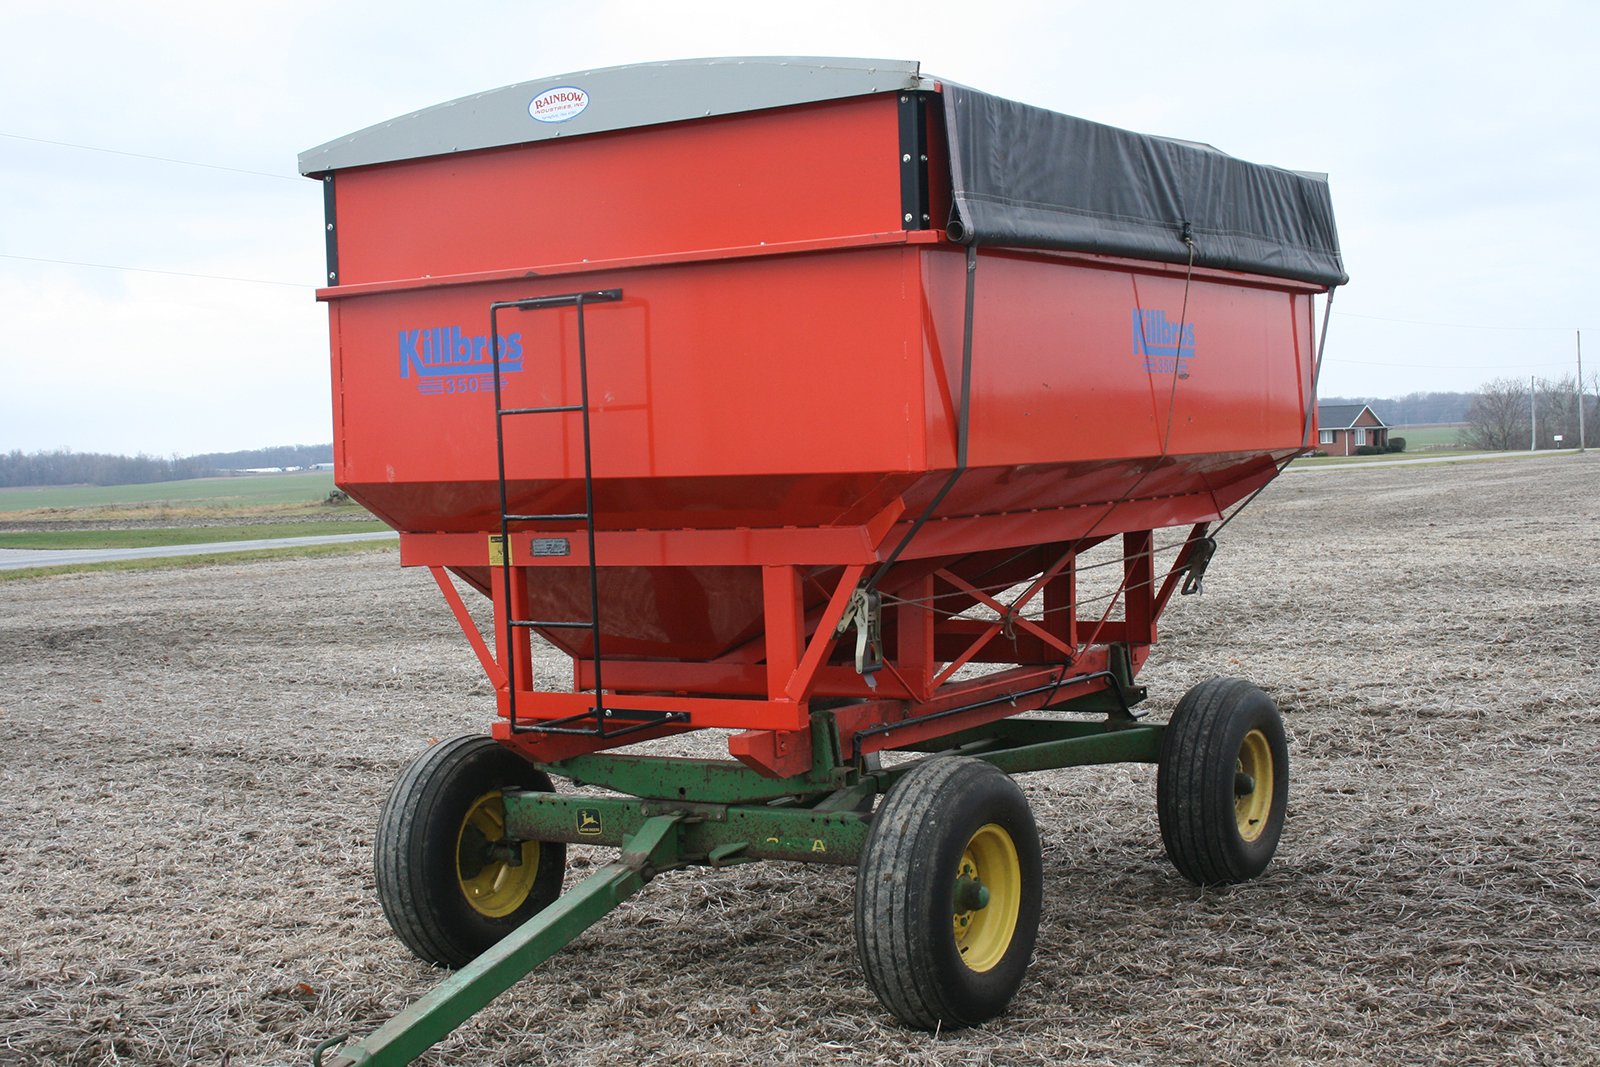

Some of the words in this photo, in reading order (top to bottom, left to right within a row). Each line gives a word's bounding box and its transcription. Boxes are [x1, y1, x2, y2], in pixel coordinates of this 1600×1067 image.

[535, 92, 584, 109] RAINBOW
[1132, 308, 1195, 357] Killbros
[399, 325, 525, 378] Killbros
[445, 377, 479, 394] 350
